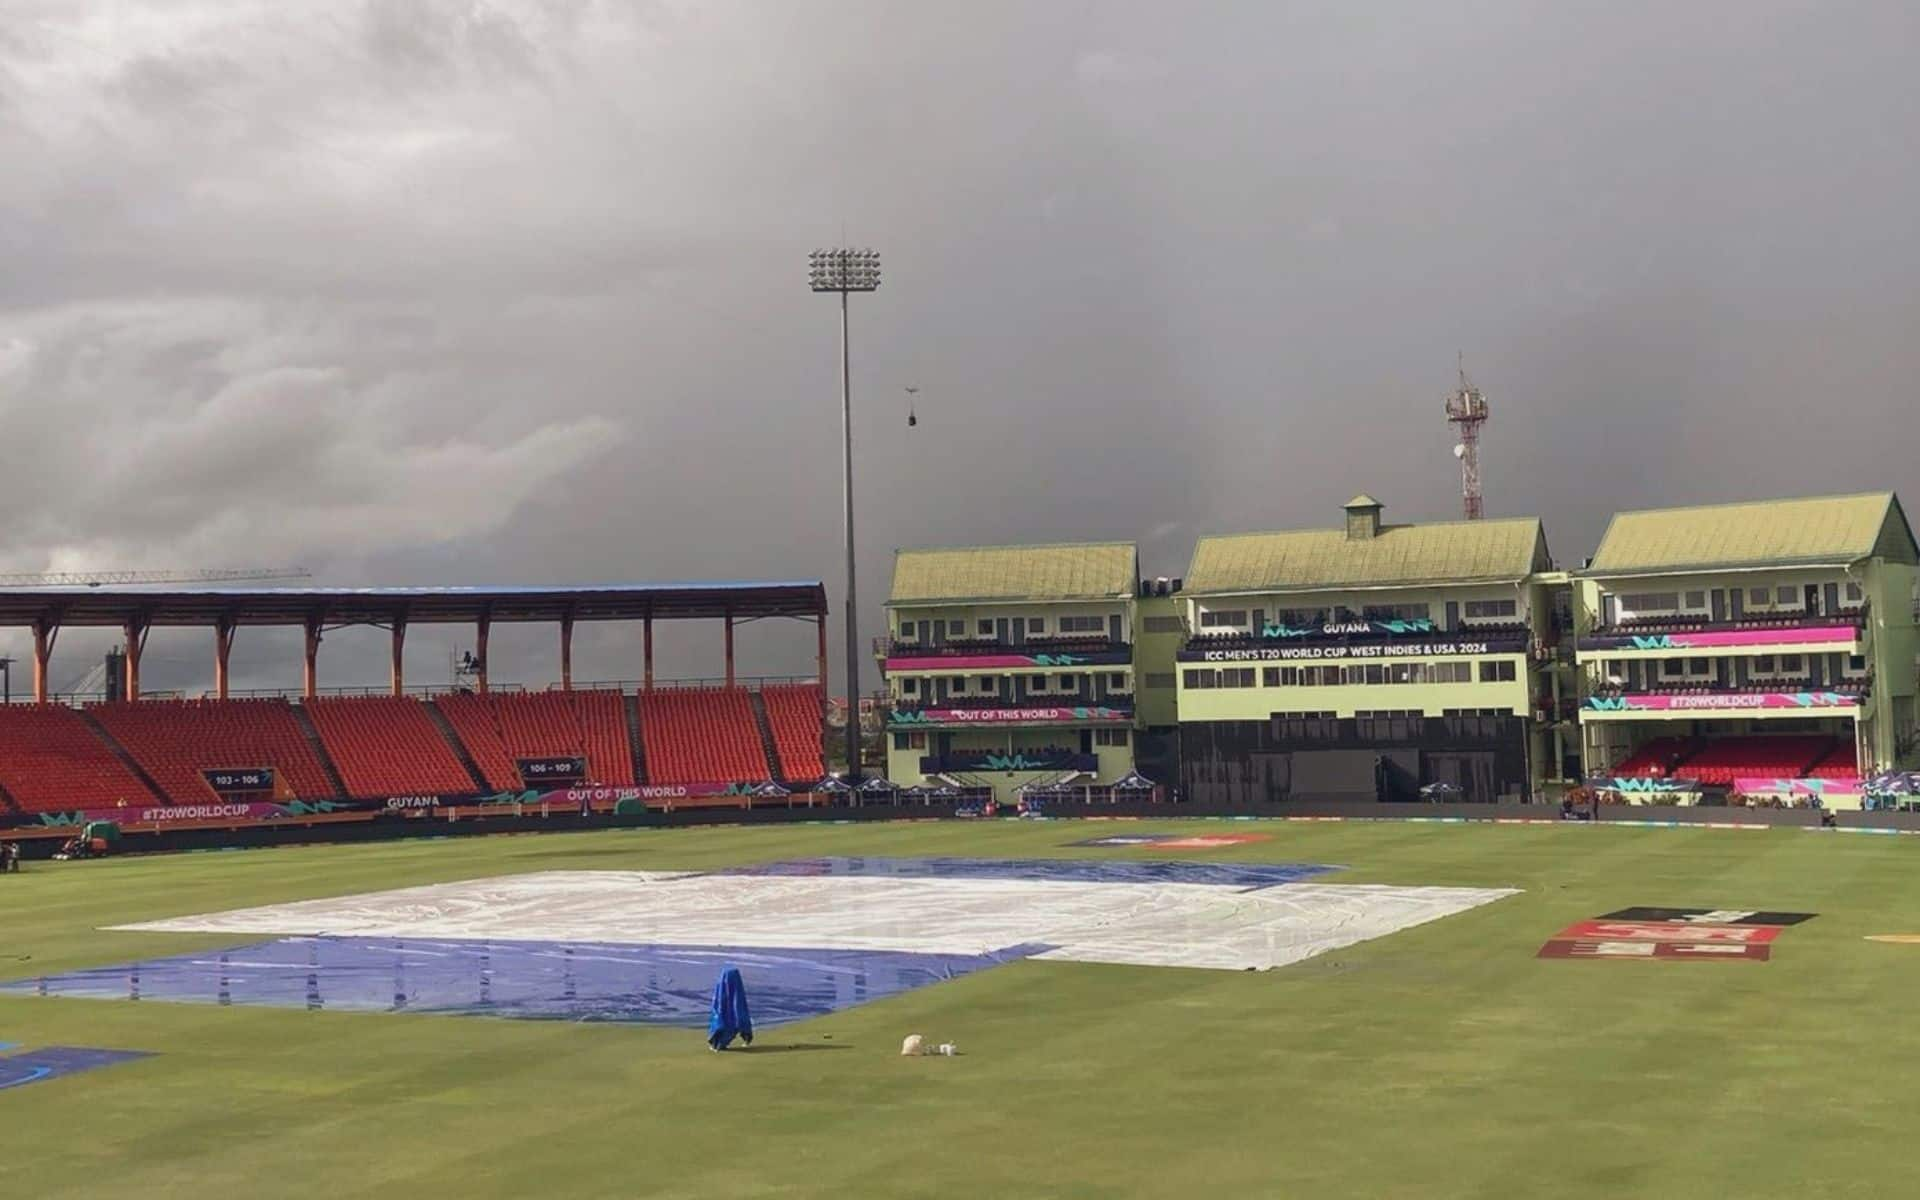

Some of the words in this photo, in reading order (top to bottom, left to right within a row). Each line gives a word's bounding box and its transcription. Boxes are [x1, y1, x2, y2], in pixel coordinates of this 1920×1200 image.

[1322, 623, 1371, 634] GUYANA
[1204, 651, 1224, 661] ICC
[1224, 650, 1258, 660] MEN'S
[1260, 649, 1280, 659] T20
[1280, 648, 1322, 659] WORLD
[1323, 647, 1347, 657] CUP
[1350, 646, 1381, 657] WEST
[1383, 644, 1422, 656] INDIES
[1423, 645, 1432, 654] &
[1433, 644, 1457, 654] USA
[1459, 643, 1487, 653] 2024
[1671, 695, 1765, 708] #T20WORLDCUP
[959, 711, 979, 720] OUT
[981, 710, 996, 719] OF
[997, 710, 1019, 719] THIS
[1020, 709, 1058, 719] WORLD
[530, 763, 546, 772] 106
[555, 763, 572, 772] 109
[216, 776, 232, 785] 103
[242, 775, 259, 784] 106
[567, 789, 592, 800] OUT
[594, 789, 612, 799] OF
[613, 787, 640, 798] THIS
[641, 786, 687, 797] WORLD
[387, 796, 440, 808] GUYANA
[142, 804, 250, 820] #T20WORLDCUP
